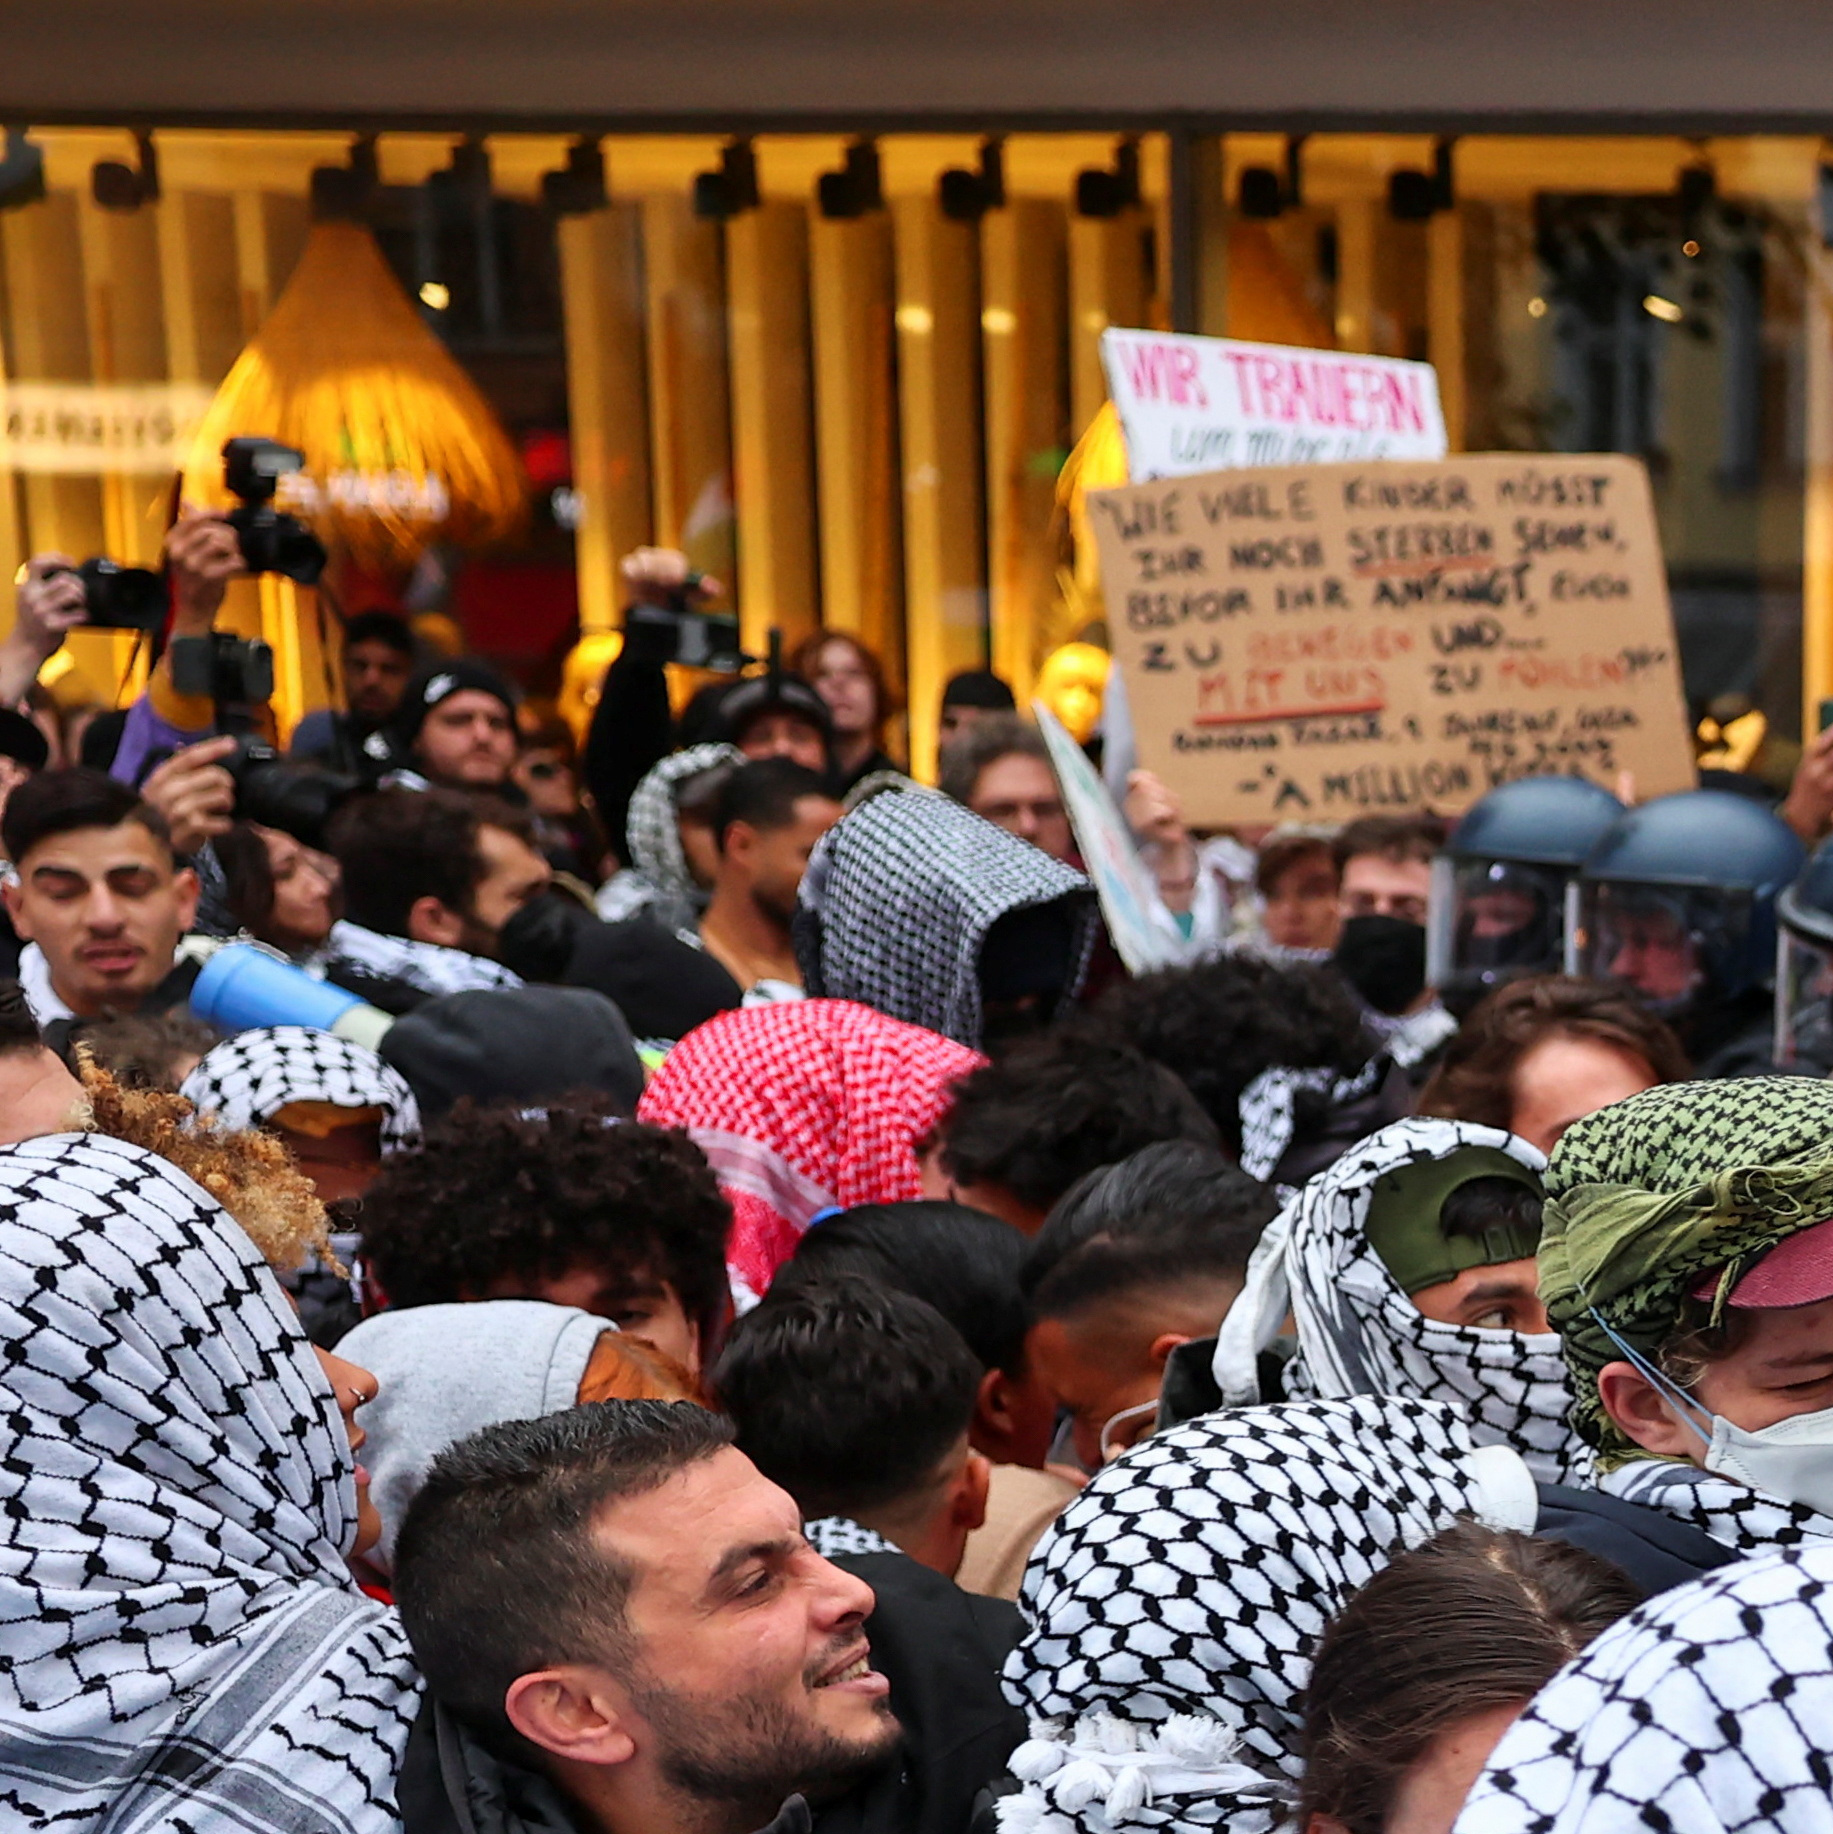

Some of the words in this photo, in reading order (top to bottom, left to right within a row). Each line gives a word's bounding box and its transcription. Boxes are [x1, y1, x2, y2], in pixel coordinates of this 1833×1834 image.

[1116, 341, 1209, 409] WIR
[1222, 350, 1426, 434] TRAUERN
[1430, 662, 1481, 694] ZU
